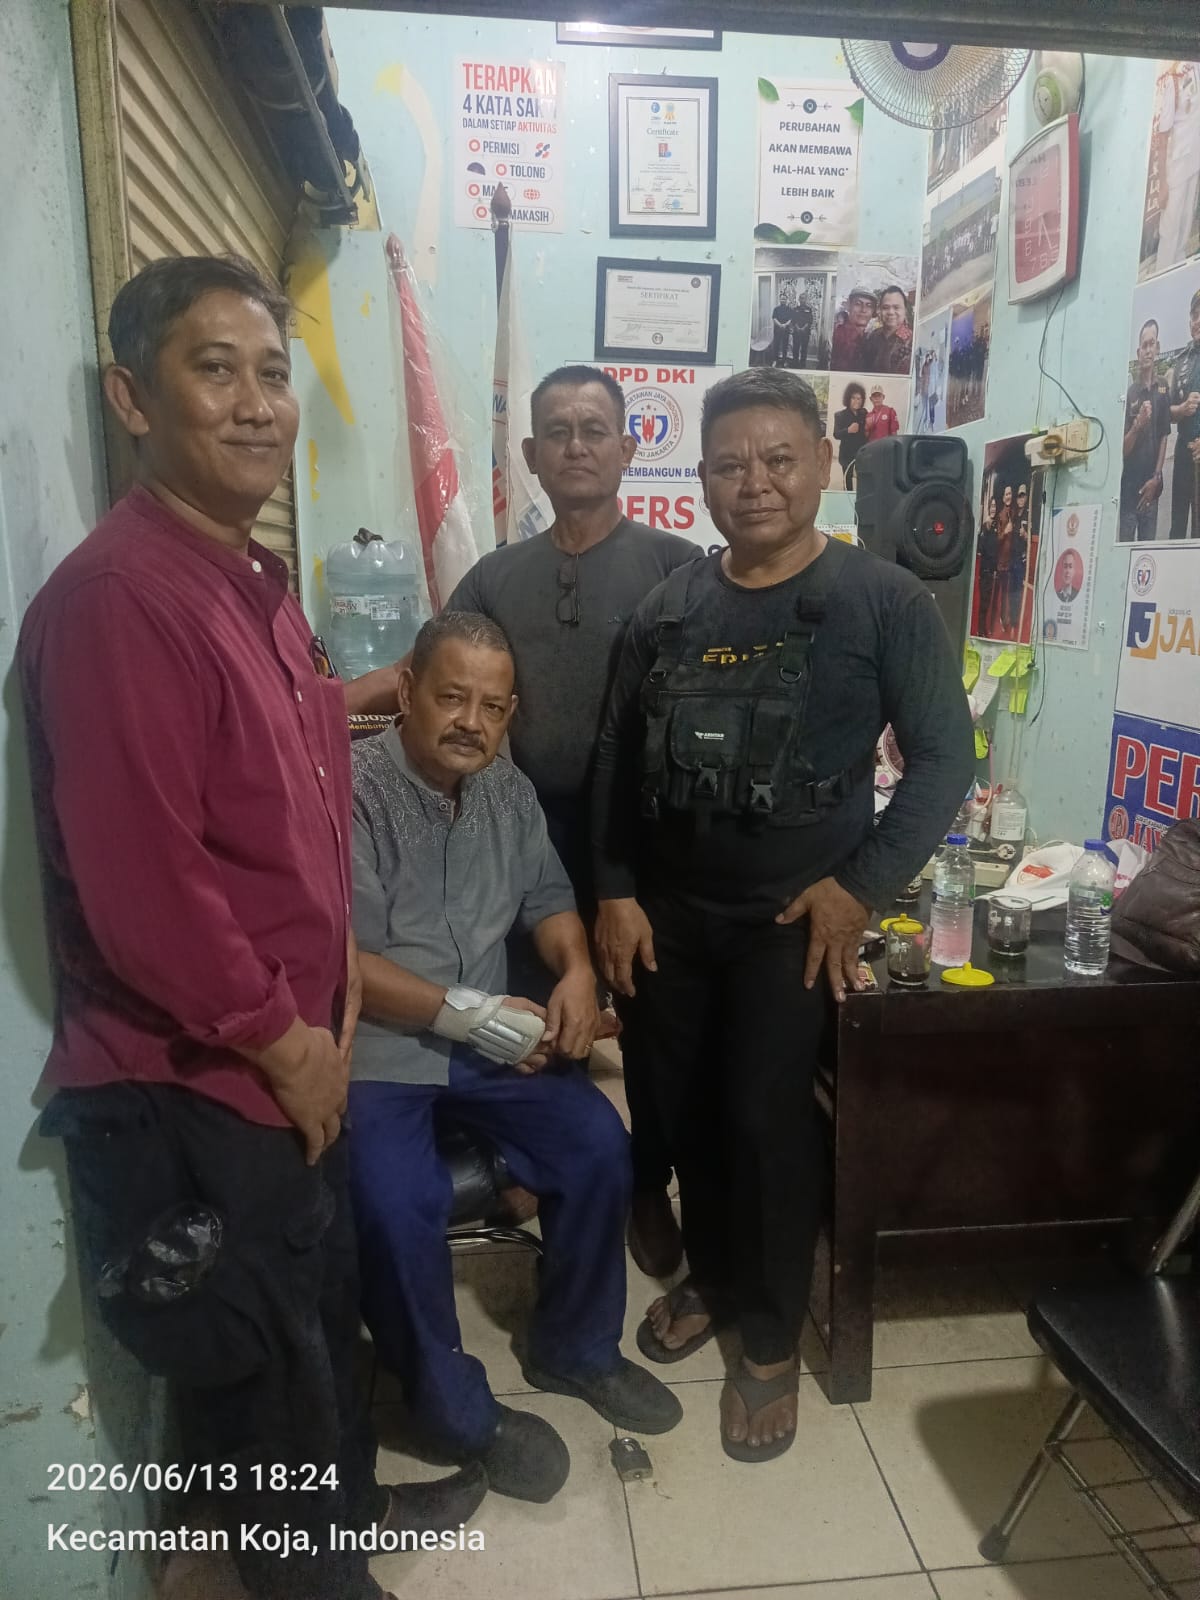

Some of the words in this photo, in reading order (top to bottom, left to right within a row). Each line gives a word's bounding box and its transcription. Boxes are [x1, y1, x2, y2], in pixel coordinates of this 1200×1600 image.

[463, 94, 473, 114] 4
[476, 94, 513, 117] KATA
[463, 118, 489, 129] DALAM
[490, 120, 517, 131] SETIAP
[518, 122, 557, 134] AKTIVITAS
[779, 121, 841, 133] PERUBAHAN
[483, 140, 520, 155] PERMISI
[768, 143, 797, 154] AKAN
[799, 144, 852, 156] MEMBAWA
[509, 164, 546, 179] TOLONG
[773, 164, 816, 175] HAL-HAL
[781, 186, 809, 197] LEBIH
[811, 188, 835, 198] BAIK
[656, 368, 695, 384] DKI
[684, 467, 697, 478] BA
[617, 495, 695, 530] ERS
[1160, 615, 1200, 656] JA
